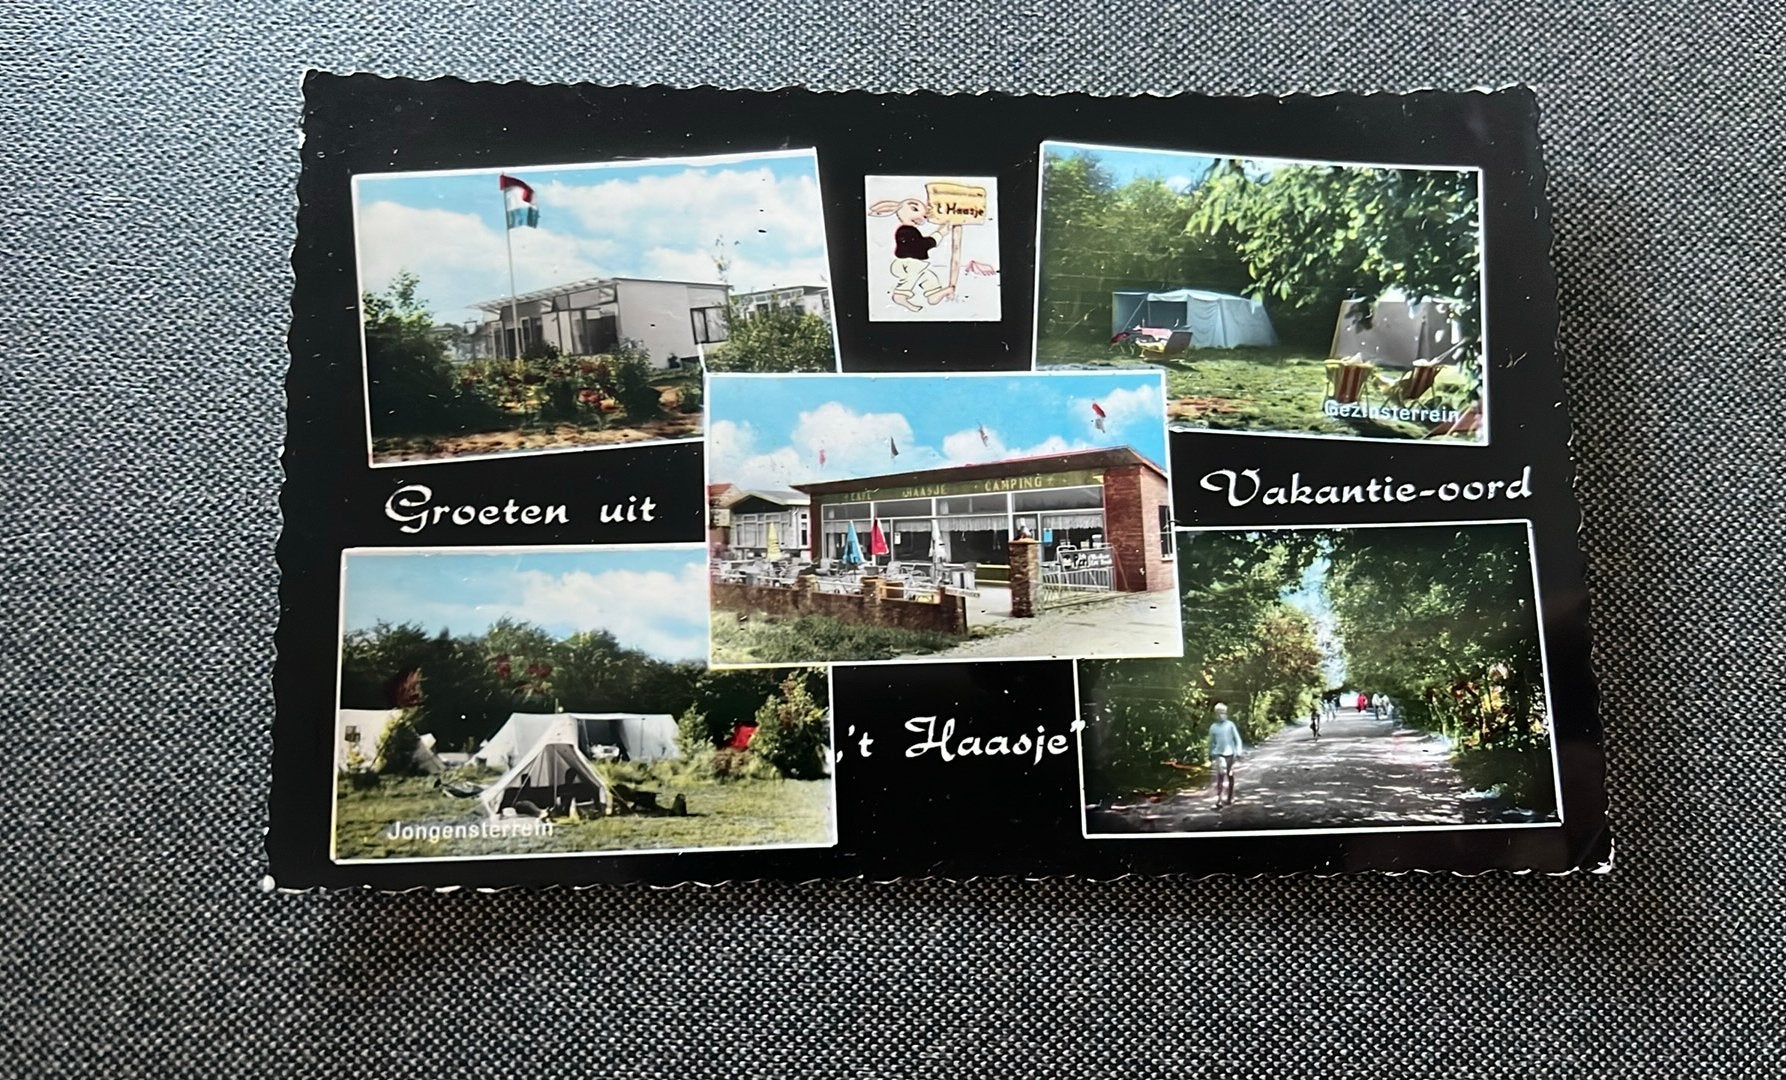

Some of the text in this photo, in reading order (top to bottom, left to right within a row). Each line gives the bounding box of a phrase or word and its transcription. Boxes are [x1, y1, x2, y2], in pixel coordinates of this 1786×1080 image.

[946, 202, 984, 218] Haasje
[1324, 399, 1459, 423] Gezinsterrein
[984, 476, 1043, 492] CAMPING
[1200, 466, 1532, 507] Vakantie-oord
[385, 485, 656, 533] Groeten uit
[387, 821, 553, 843] Jongensterrein
